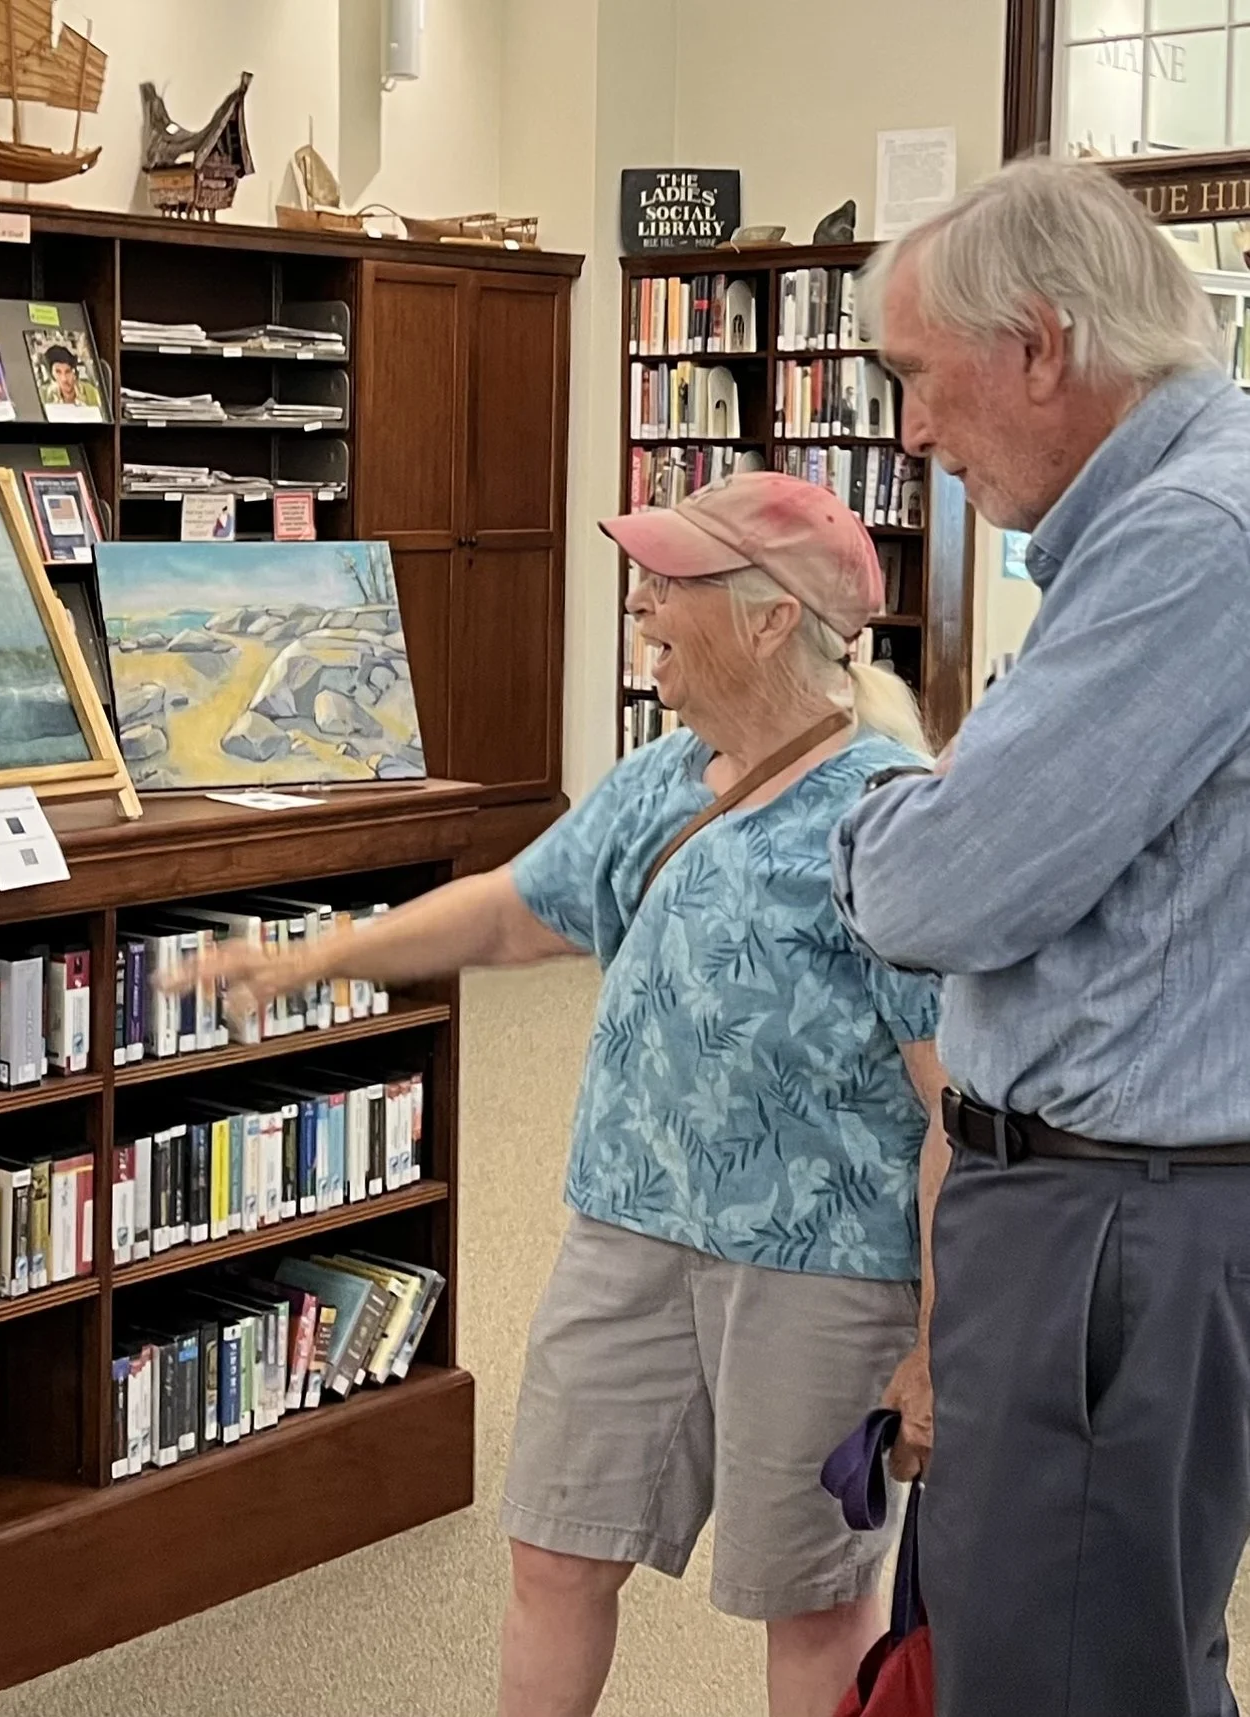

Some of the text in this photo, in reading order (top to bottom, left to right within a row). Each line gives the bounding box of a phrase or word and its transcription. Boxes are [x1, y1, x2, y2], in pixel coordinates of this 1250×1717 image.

[656, 173, 699, 188] THE
[639, 186, 718, 207] LADIES'
[645, 205, 717, 221] SOCIAL
[637, 221, 725, 237] LIBRARY
[631, 454, 641, 503] ATWOOD
